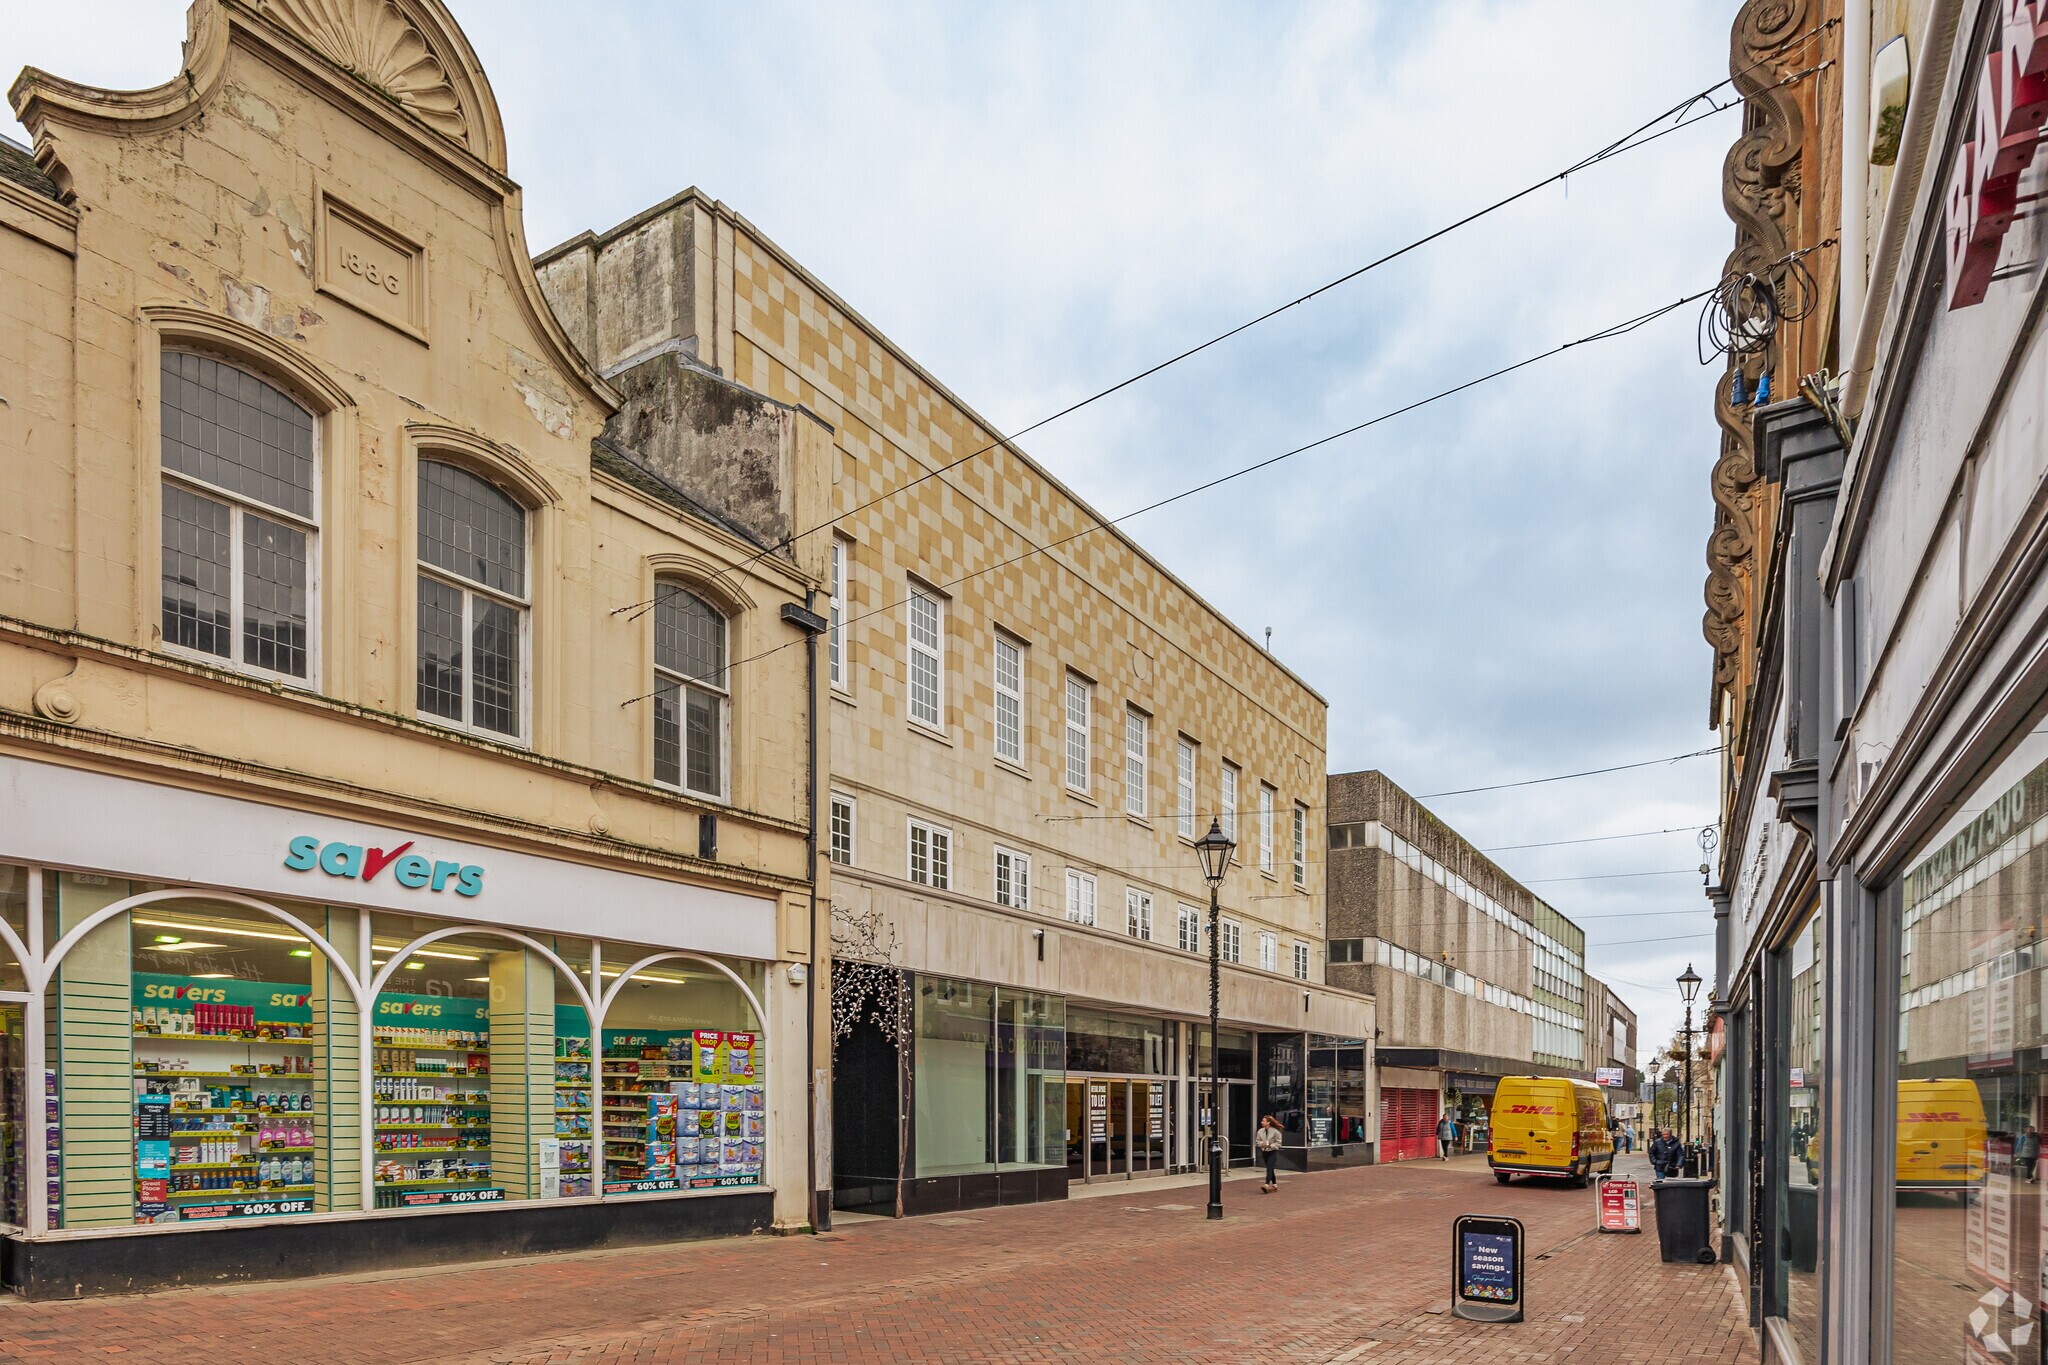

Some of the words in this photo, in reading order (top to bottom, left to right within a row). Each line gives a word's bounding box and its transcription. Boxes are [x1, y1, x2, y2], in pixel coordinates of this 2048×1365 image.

[340, 245, 400, 296] 1886
[283, 835, 486, 898] savers
[143, 982, 226, 1003] savers
[379, 1000, 442, 1017] savers
[612, 1034, 648, 1046] savers
[1510, 1104, 1556, 1116] DHL
[636, 1181, 657, 1191] 60%
[659, 1180, 674, 1189] OFF
[720, 1177, 739, 1186] 60%
[740, 1176, 754, 1185] OFF
[451, 1191, 477, 1202] 60%
[478, 1190, 499, 1200] OFF
[243, 1202, 277, 1215] 60%
[280, 1201, 305, 1212] OFF
[1478, 1246, 1498, 1254] New
[1472, 1254, 1504, 1263] season
[1471, 1262, 1505, 1272] savings
